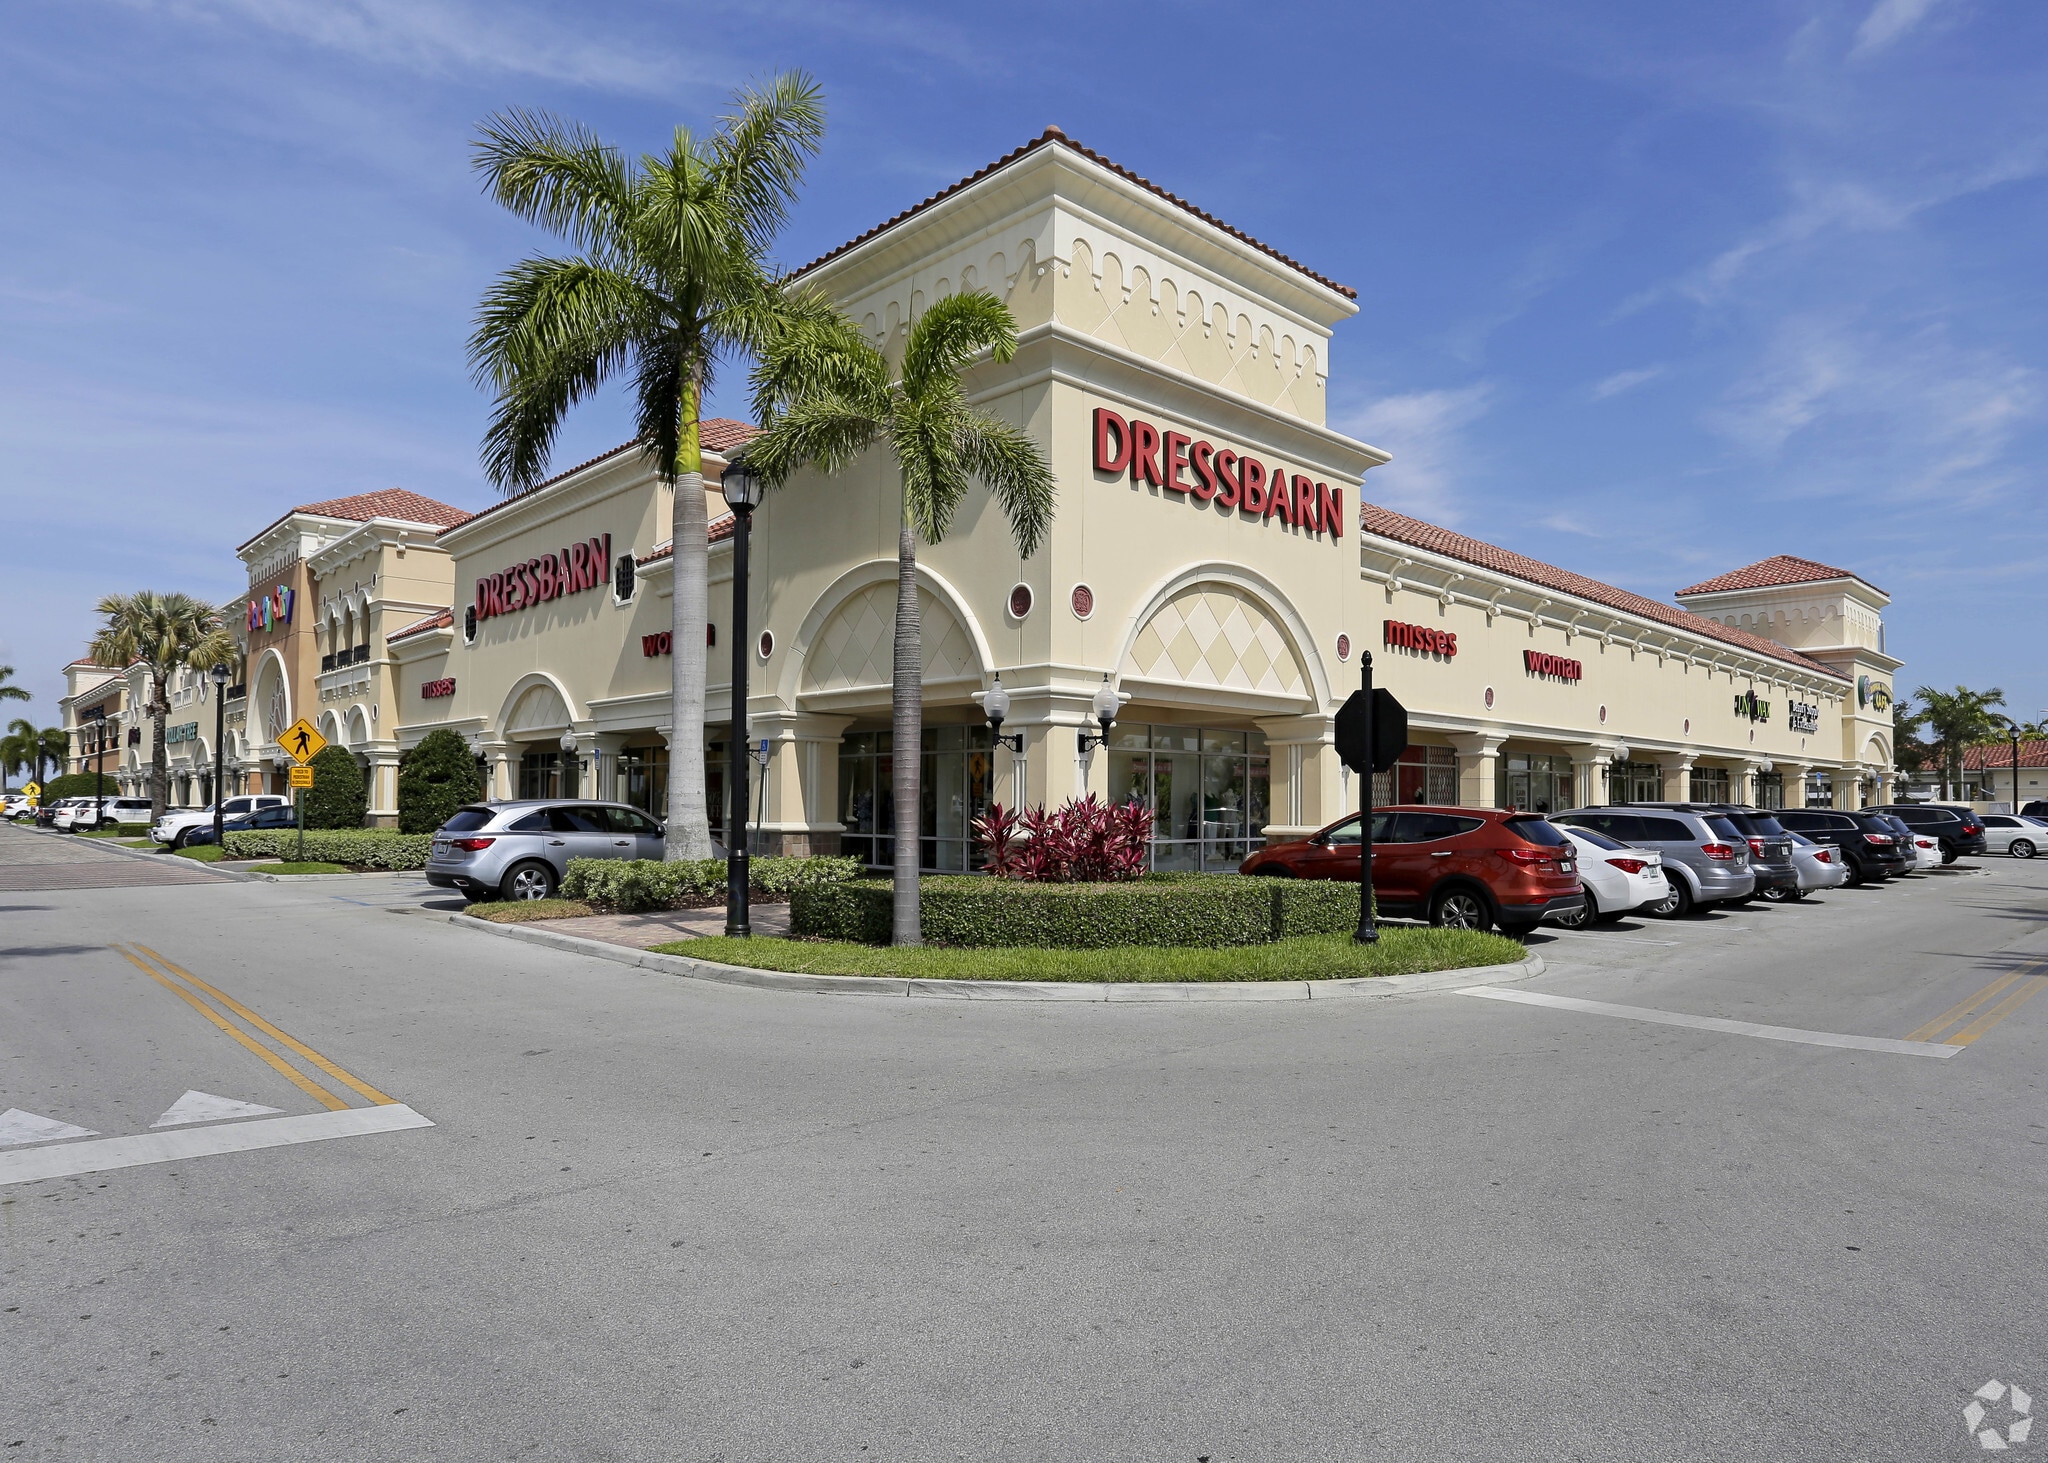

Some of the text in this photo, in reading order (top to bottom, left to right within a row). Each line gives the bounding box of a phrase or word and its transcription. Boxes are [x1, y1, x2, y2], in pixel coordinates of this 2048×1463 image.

[1093, 407, 1343, 537] DRESSBARN
[476, 533, 611, 621] DRESSBARN
[1384, 619, 1457, 656] misses
[1523, 650, 1582, 680] woman
[421, 677, 456, 699] misses
